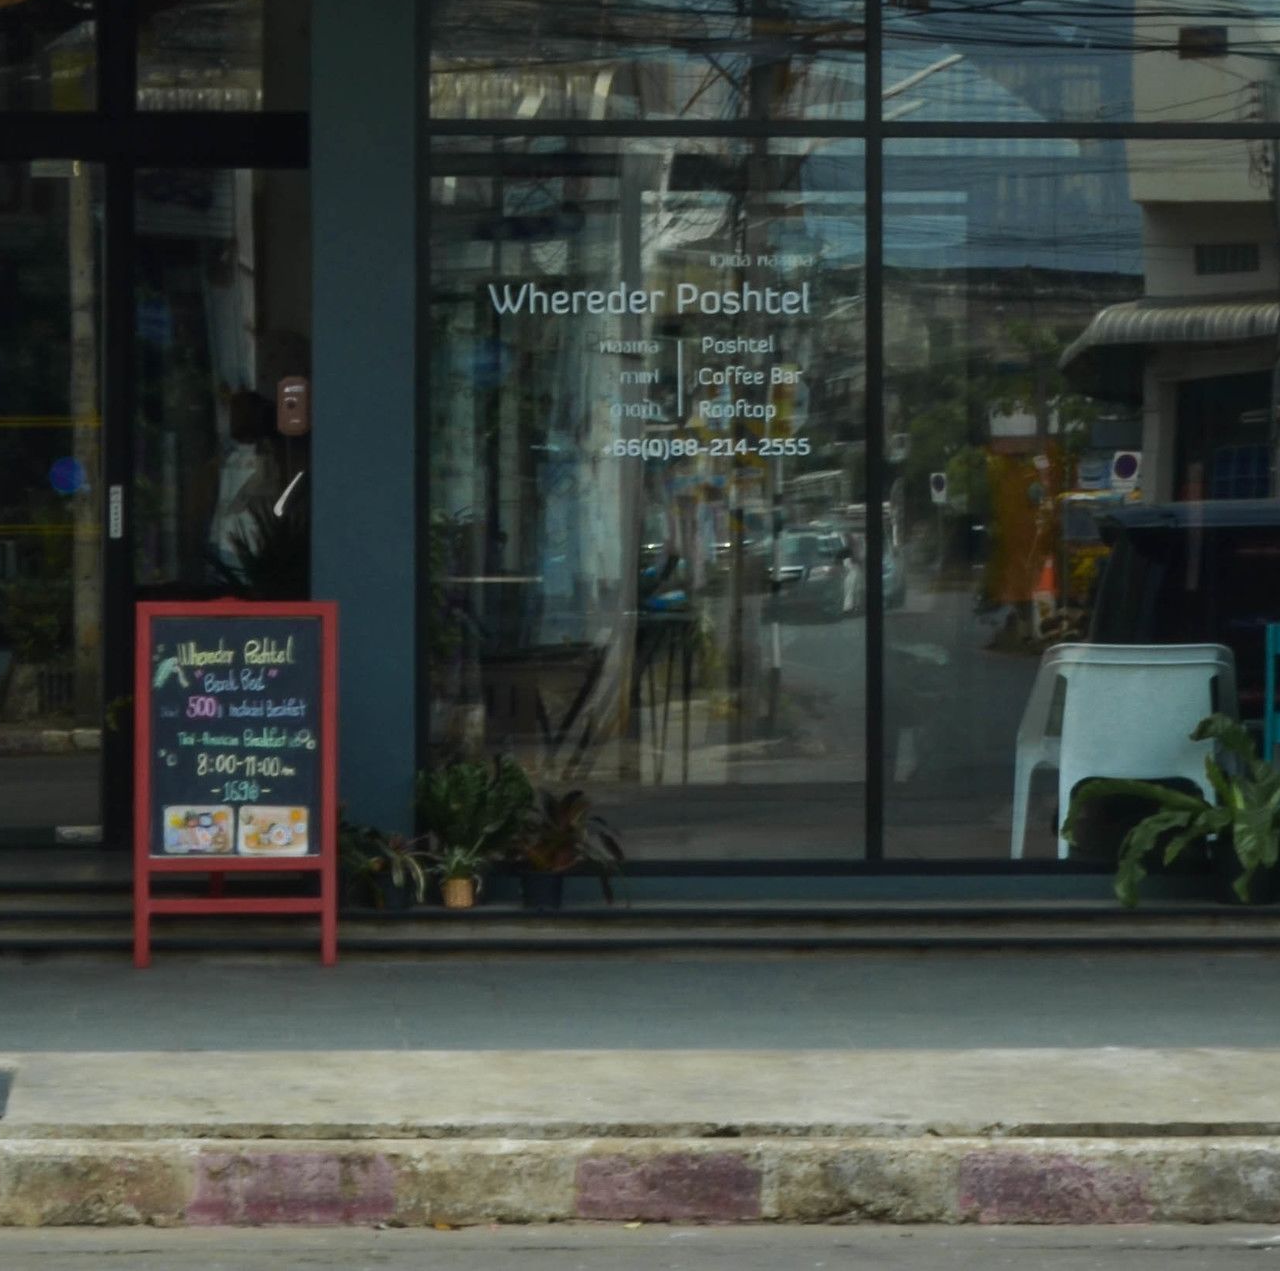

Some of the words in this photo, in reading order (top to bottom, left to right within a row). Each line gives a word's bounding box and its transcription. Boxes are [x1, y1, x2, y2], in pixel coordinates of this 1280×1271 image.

[488, 281, 665, 315] Whereder
[677, 282, 811, 315] Poshtel
[701, 334, 774, 354] Poshtel
[698, 366, 765, 386] Coffee
[770, 366, 803, 385] Bar
[699, 398, 777, 424] Rooftop
